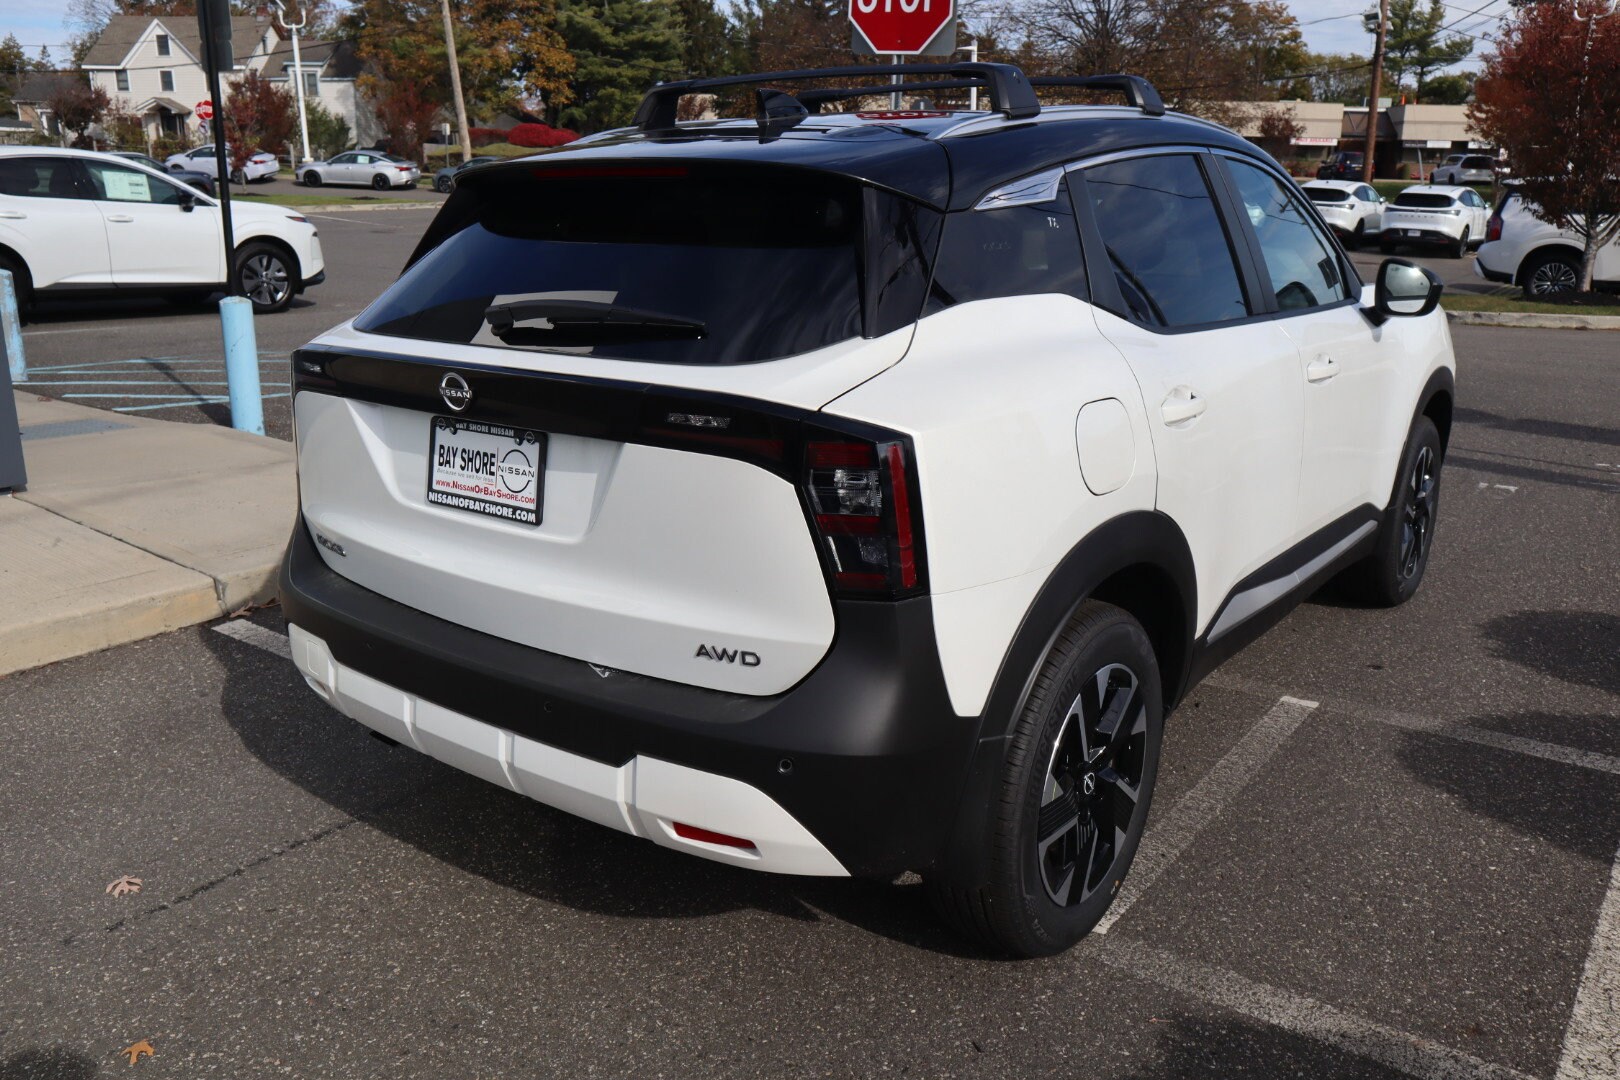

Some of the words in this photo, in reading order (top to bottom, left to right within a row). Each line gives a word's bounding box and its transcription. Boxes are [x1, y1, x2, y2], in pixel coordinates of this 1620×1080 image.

[439, 388, 471, 399] NISSAN
[469, 424, 489, 433] SHORE
[491, 426, 514, 437] NISSAN
[438, 444, 458, 469] BAY
[460, 448, 496, 476] SHORE
[498, 465, 535, 478] NISSAN
[428, 492, 536, 523] NISSANOFBAYSHORE.COM
[696, 644, 761, 667] AWD
